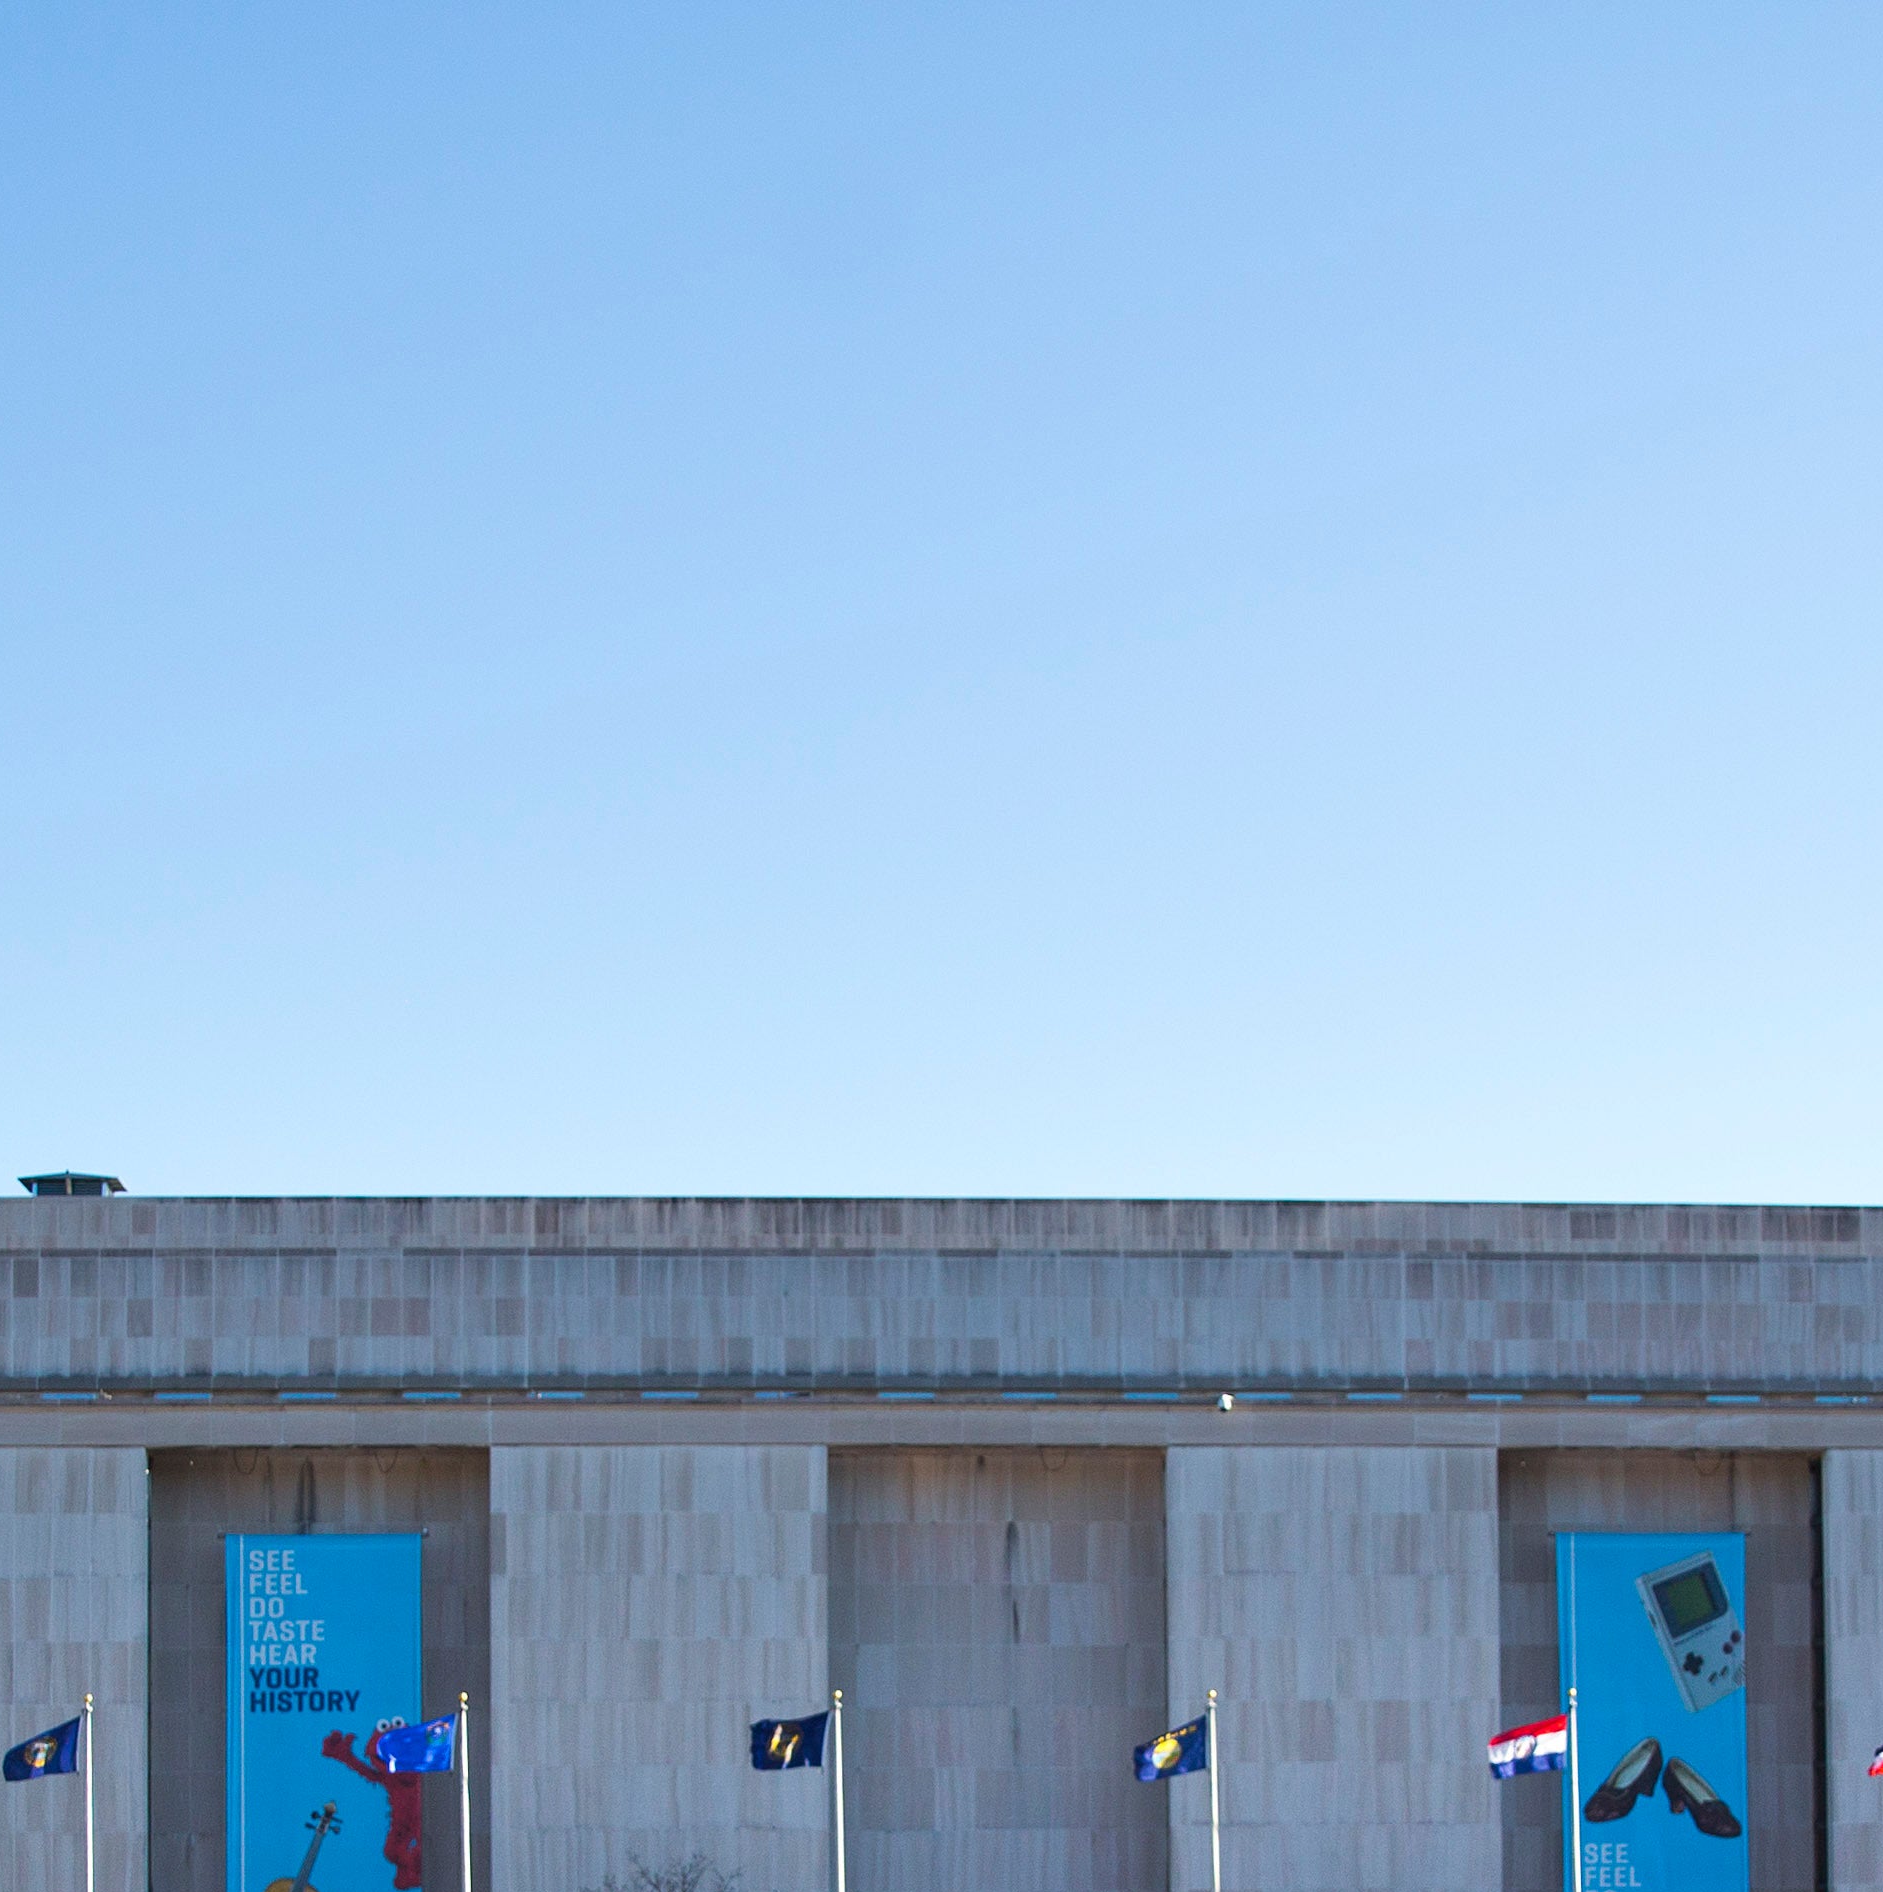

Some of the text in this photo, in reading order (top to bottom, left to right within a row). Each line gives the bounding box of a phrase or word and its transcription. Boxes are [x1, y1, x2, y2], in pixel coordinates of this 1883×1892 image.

[249, 1550, 295, 1571] SEE
[249, 1573, 308, 1595] FEEL
[249, 1597, 284, 1618] DO
[249, 1620, 325, 1642] TASTE
[249, 1644, 317, 1665] HEAR
[249, 1667, 319, 1689] YOUR
[249, 1690, 360, 1713] HISTORY
[1584, 1843, 1629, 1864] SEE
[1584, 1866, 1642, 1888] FEEL
